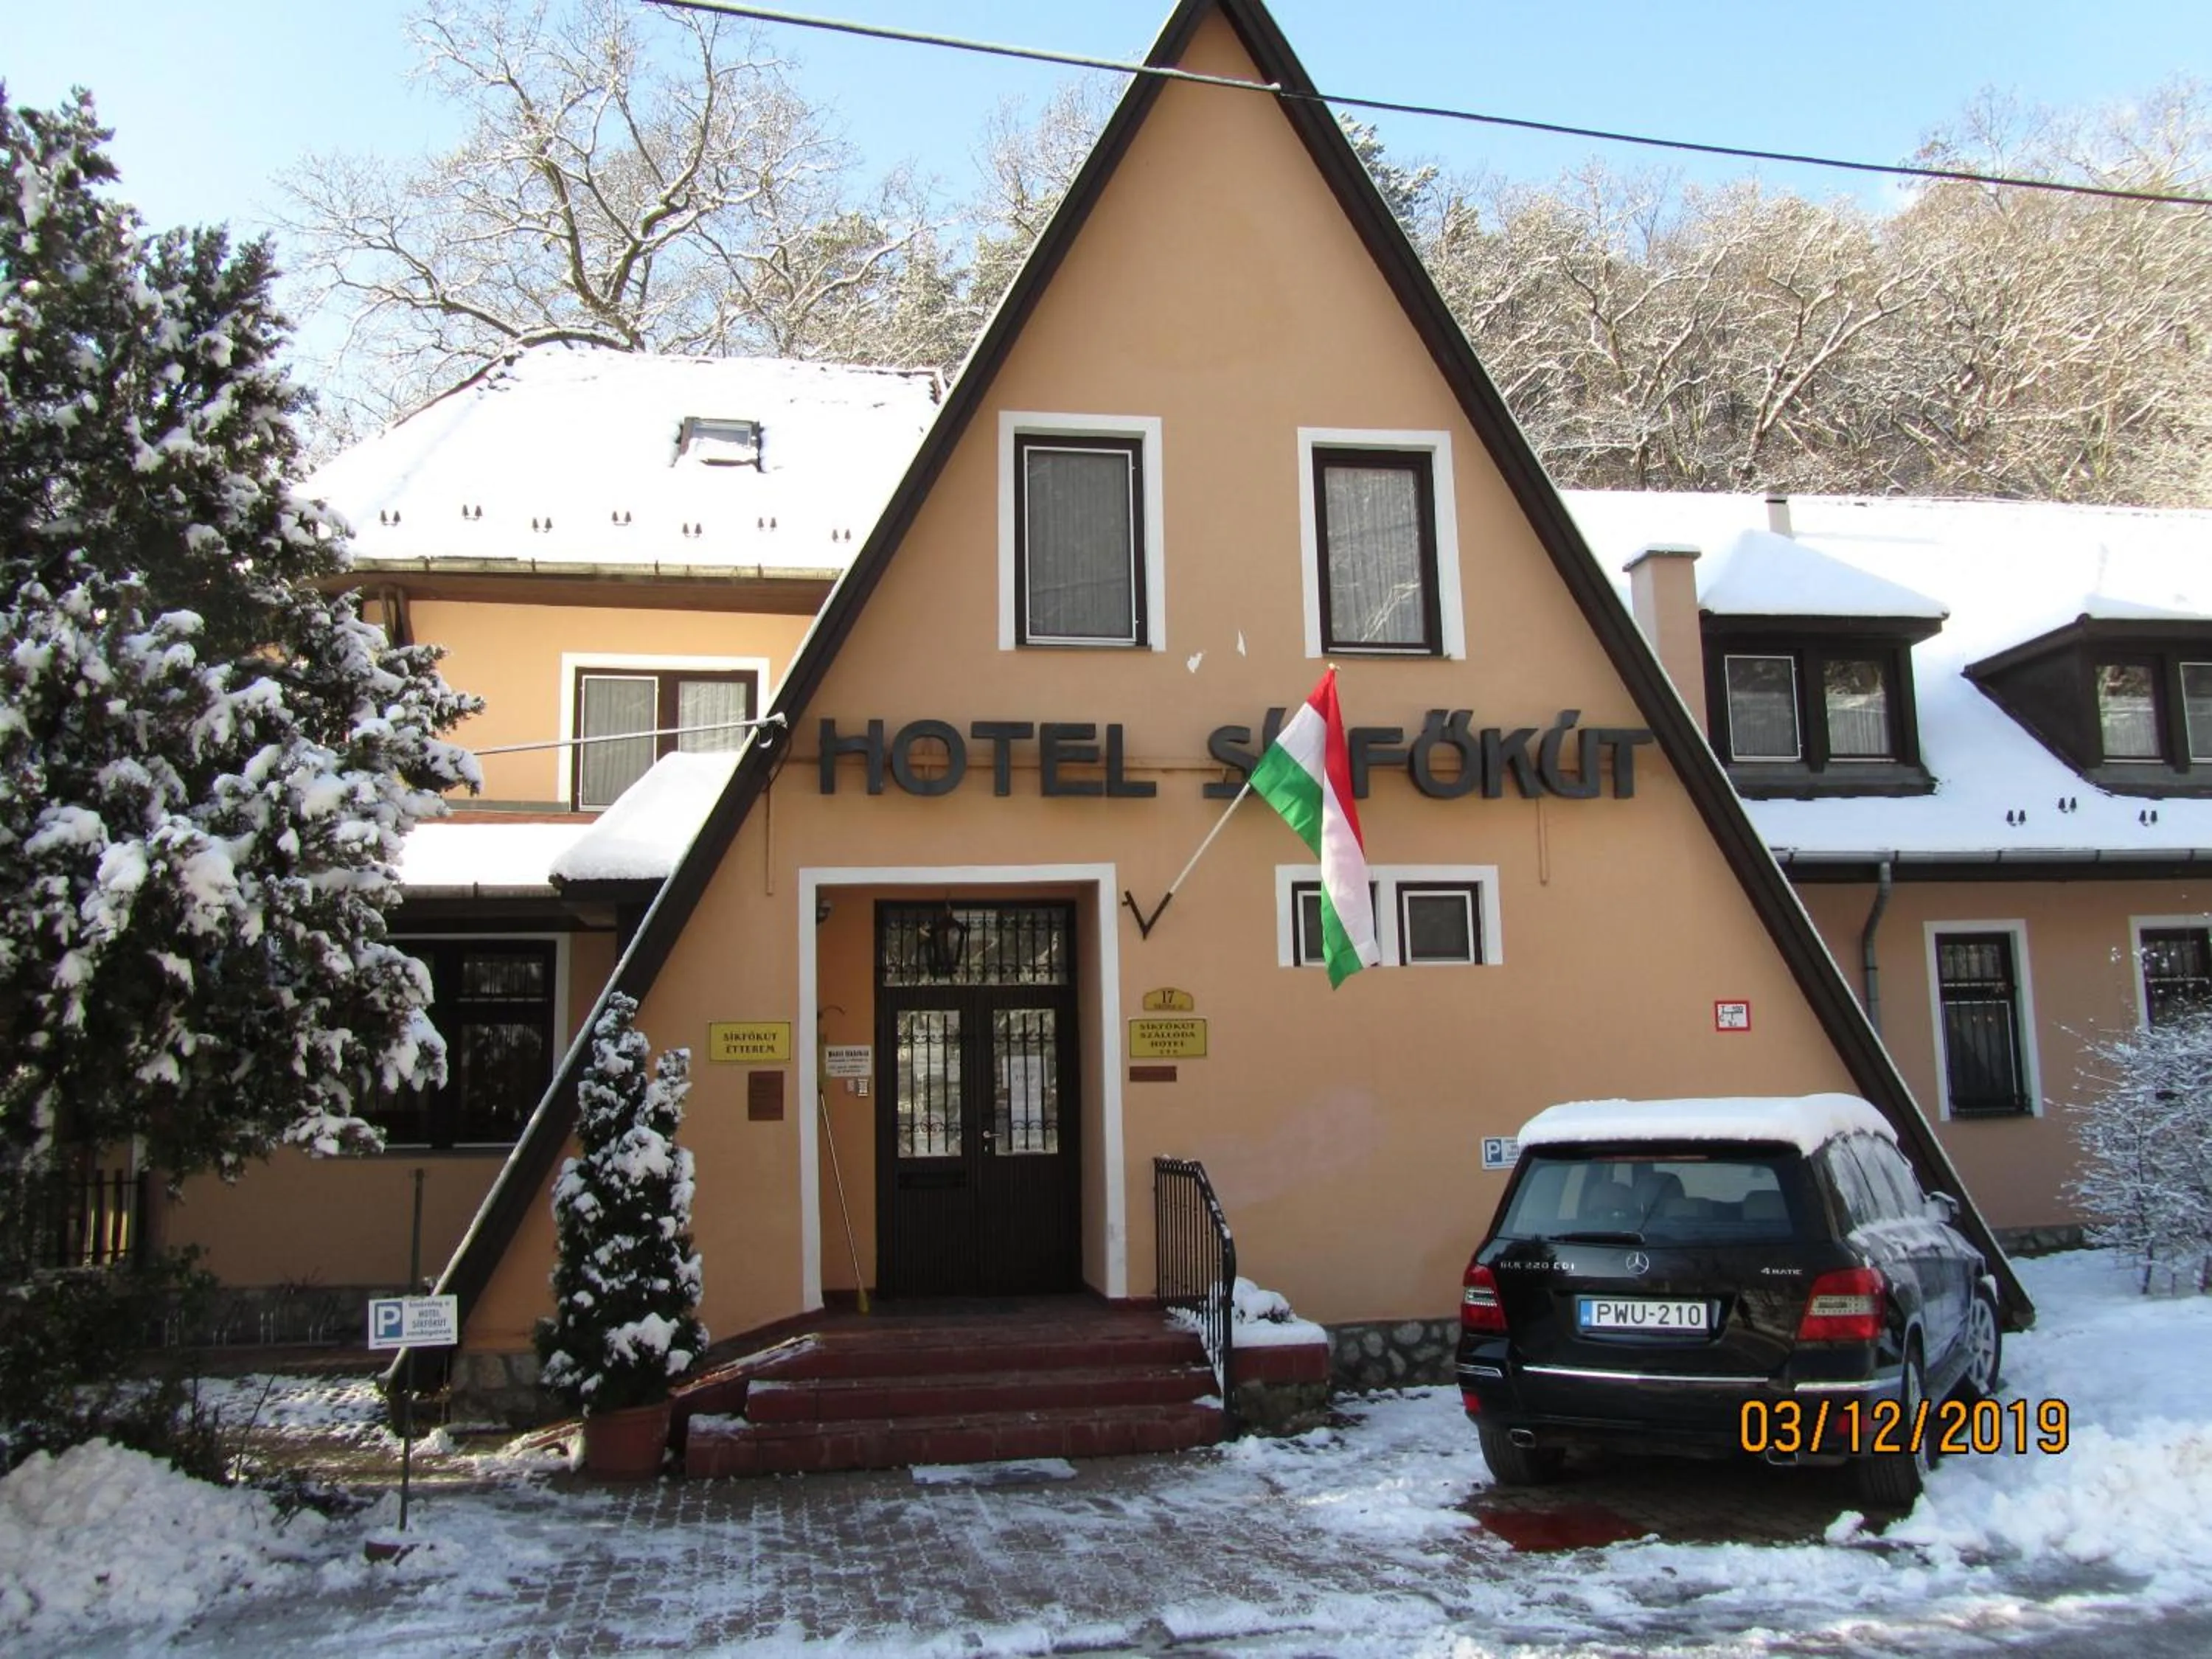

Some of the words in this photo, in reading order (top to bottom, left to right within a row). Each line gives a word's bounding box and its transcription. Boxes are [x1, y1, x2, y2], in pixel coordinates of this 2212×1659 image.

[819, 718, 1157, 798] HOTEL
[1203, 708, 1654, 799] SÍFŐKÚT
[1162, 990, 1175, 1004] 17
[1150, 1040, 1184, 1048] HOTEL
[1486, 1141, 1500, 1161] P
[377, 1306, 401, 1335] P
[1596, 1303, 1701, 1326] PWU-210
